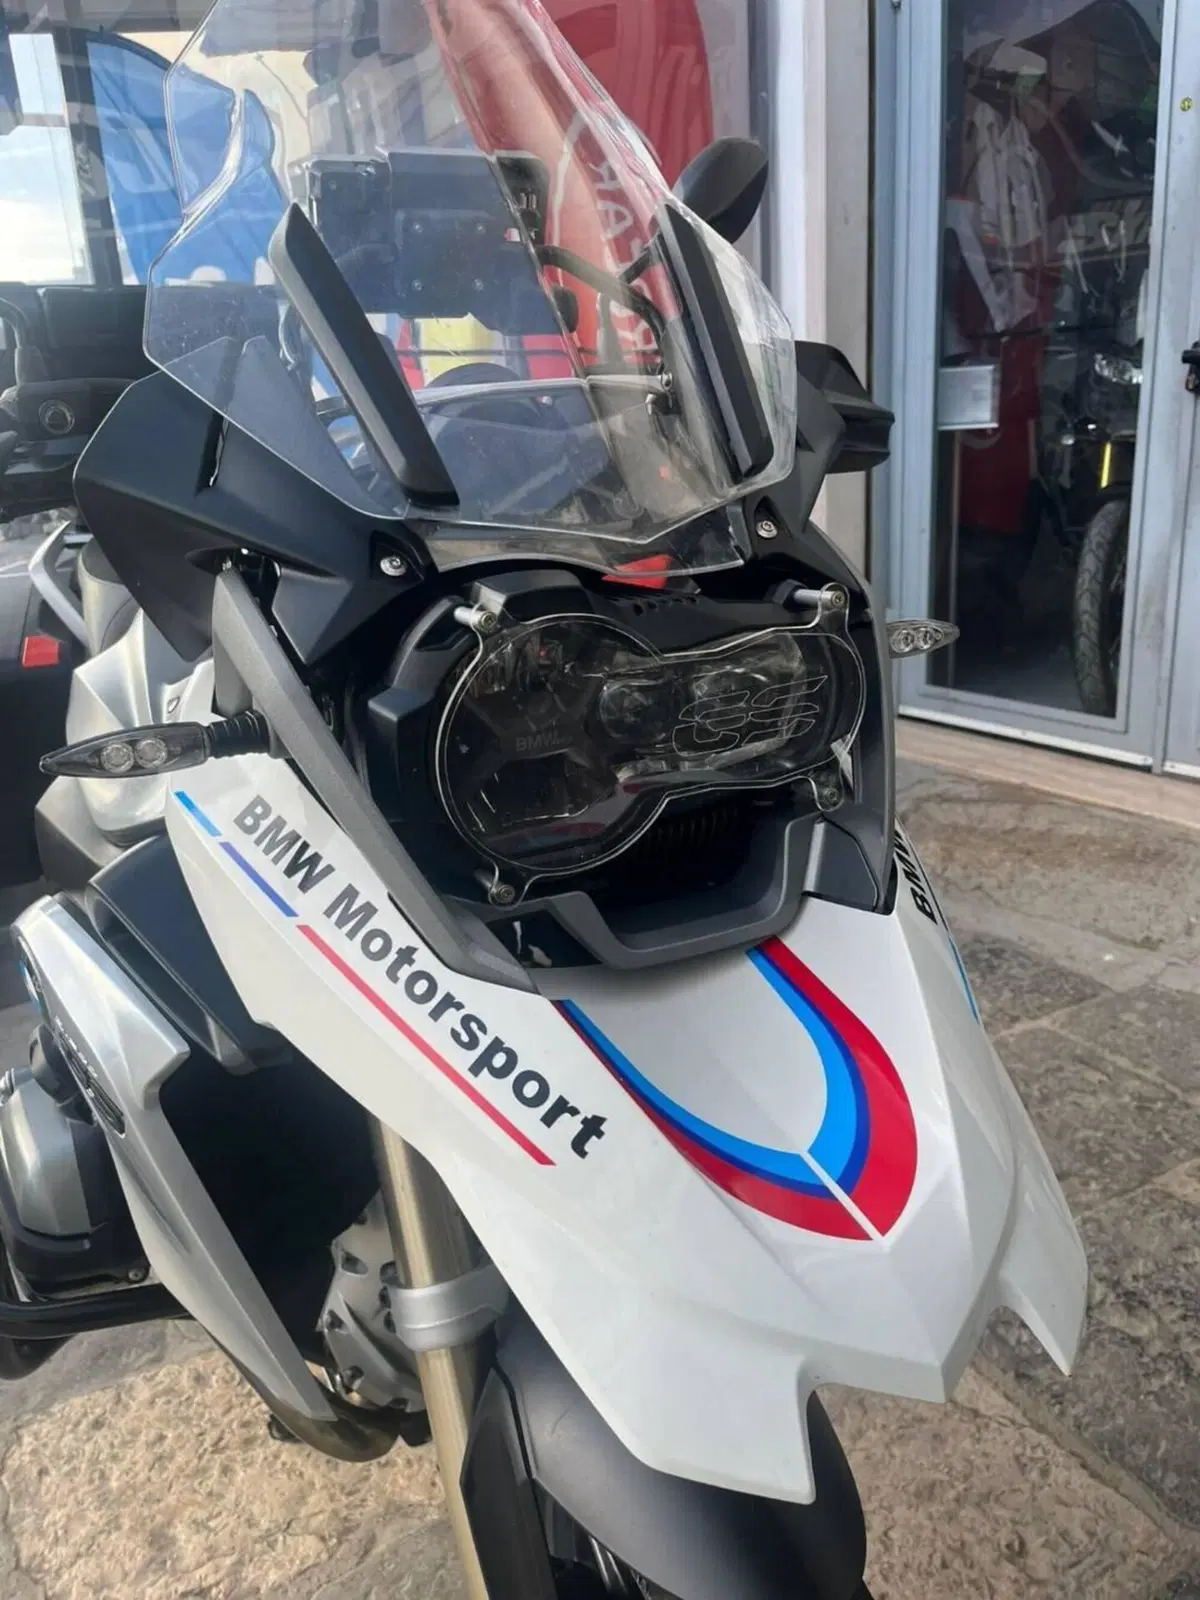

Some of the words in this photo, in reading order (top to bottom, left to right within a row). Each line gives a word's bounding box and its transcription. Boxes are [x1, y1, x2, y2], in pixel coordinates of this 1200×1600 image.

[515, 729, 562, 752] BMW
[233, 794, 335, 895] BMW
[323, 883, 608, 1159] Motorsport
